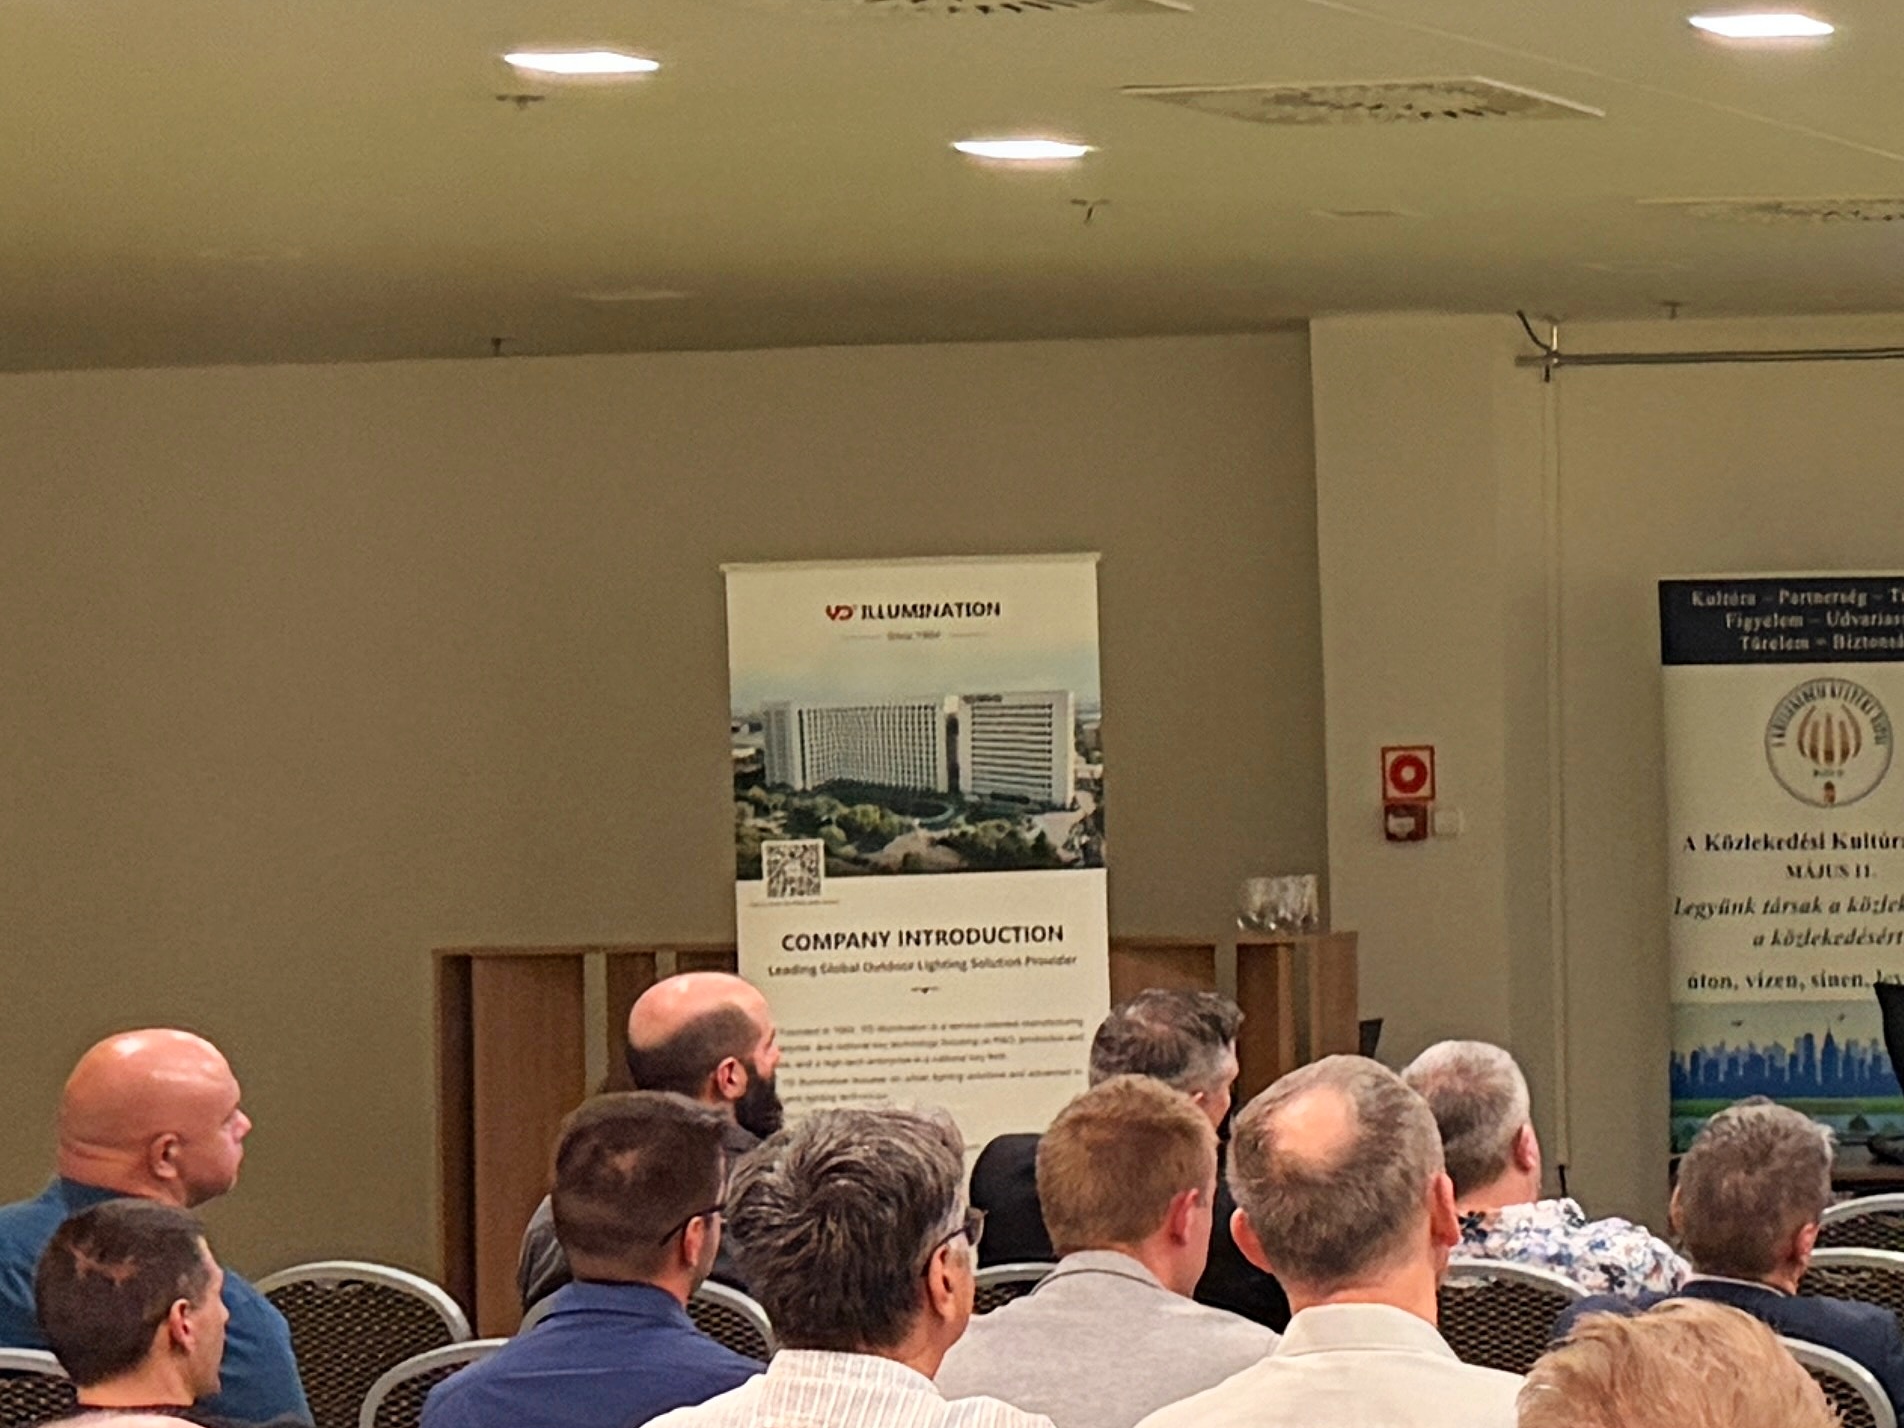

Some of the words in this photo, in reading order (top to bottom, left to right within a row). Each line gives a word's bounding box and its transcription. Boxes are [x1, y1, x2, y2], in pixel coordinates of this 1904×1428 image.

[861, 601, 1001, 620] ILLUMINATION
[1726, 611, 1804, 633] Figyelem
[1683, 835, 1697, 853] A
[1704, 831, 1826, 852] Közlekedési
[1786, 860, 1849, 880] MÁJUS
[1673, 895, 1755, 920] Legyünk
[1762, 895, 1823, 915] társak
[1828, 901, 1841, 915] a
[782, 929, 891, 951] COMPANY
[898, 924, 1064, 947] INTRODUCTION
[1752, 934, 1765, 948] a
[1770, 926, 1904, 949] közlekedésért
[768, 963, 818, 978] Leading
[917, 957, 968, 973] Lighting
[971, 955, 1022, 970] Solution
[1024, 953, 1077, 967] Provider
